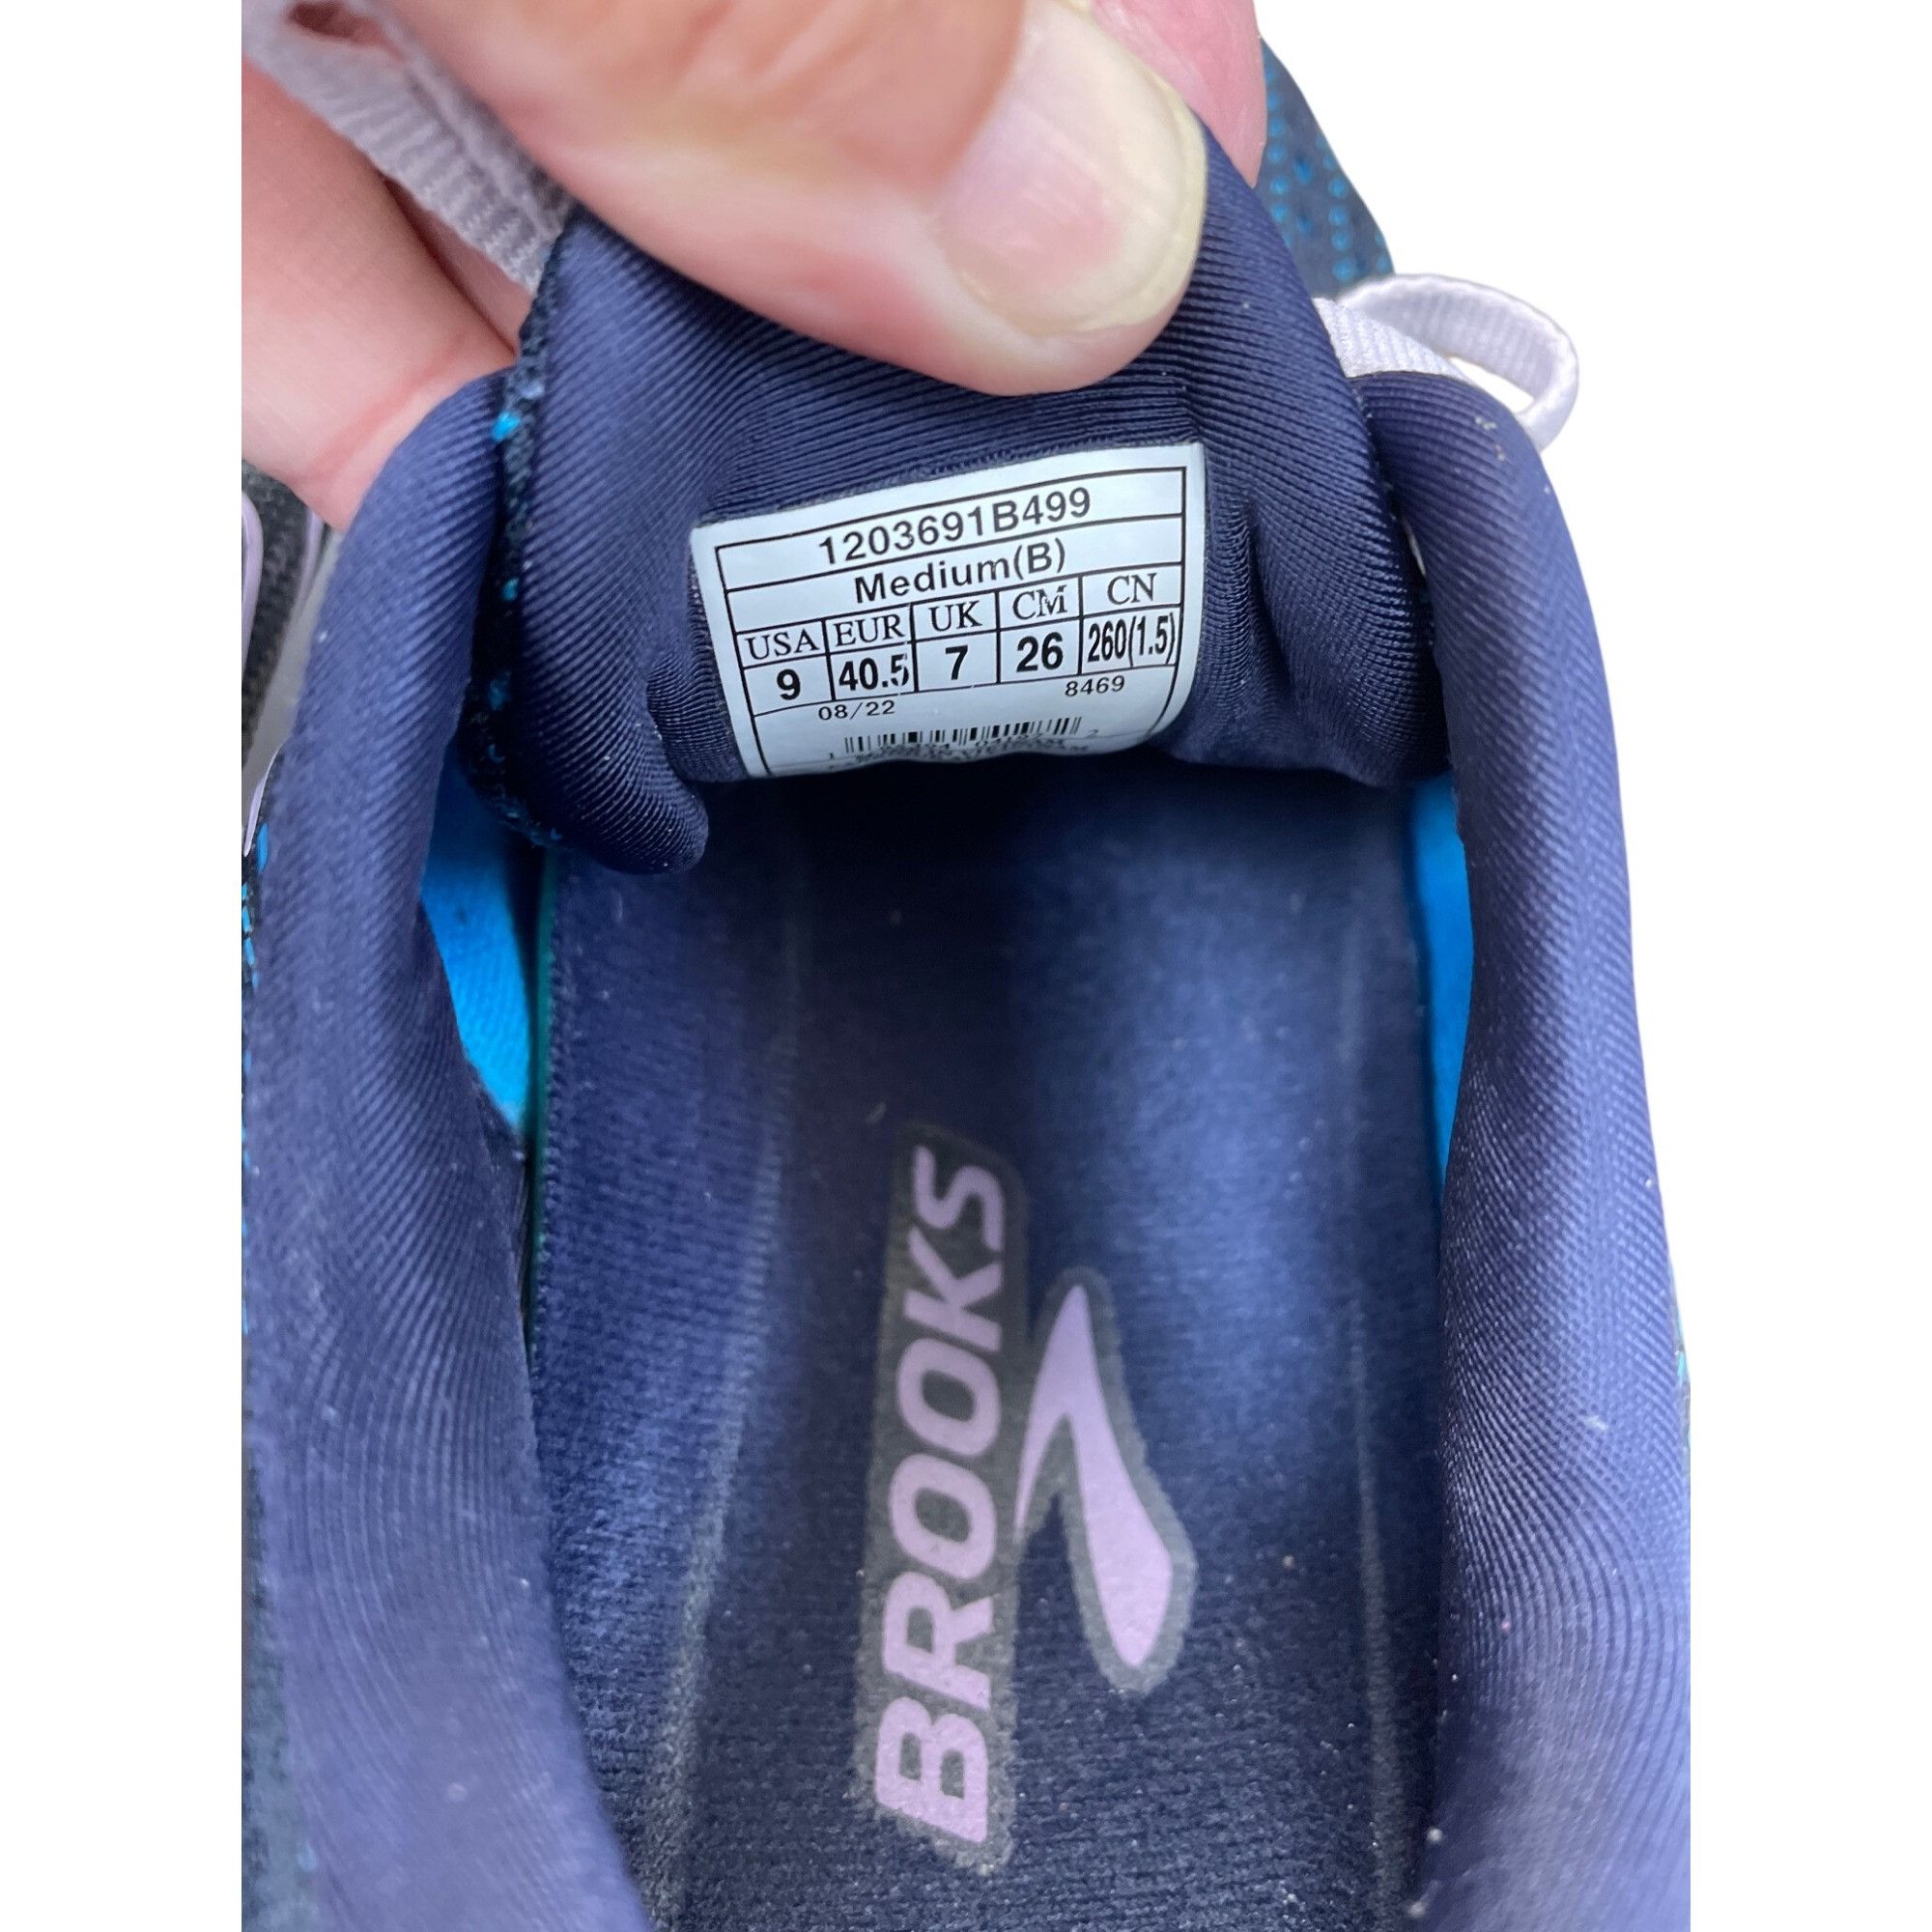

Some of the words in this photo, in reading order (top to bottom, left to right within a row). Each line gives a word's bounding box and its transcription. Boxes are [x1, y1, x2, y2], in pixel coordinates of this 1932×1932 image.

[819, 487, 1091, 565] 1203691B499
[854, 537, 1066, 604] Medium(B)
[746, 628, 820, 661] USA
[833, 613, 906, 647] EUR
[928, 600, 982, 632] UK
[1012, 584, 1067, 620] CM
[1107, 573, 1157, 605] CN
[776, 668, 801, 701] 9
[838, 653, 910, 692] 40.5
[945, 644, 969, 681] 7
[1016, 631, 1064, 672] 26
[1087, 611, 1177, 668] 260(1.5)
[818, 699, 895, 721] 08/22
[1065, 675, 1125, 697] 8469
[873, 1145, 1005, 1843] BROOKS
